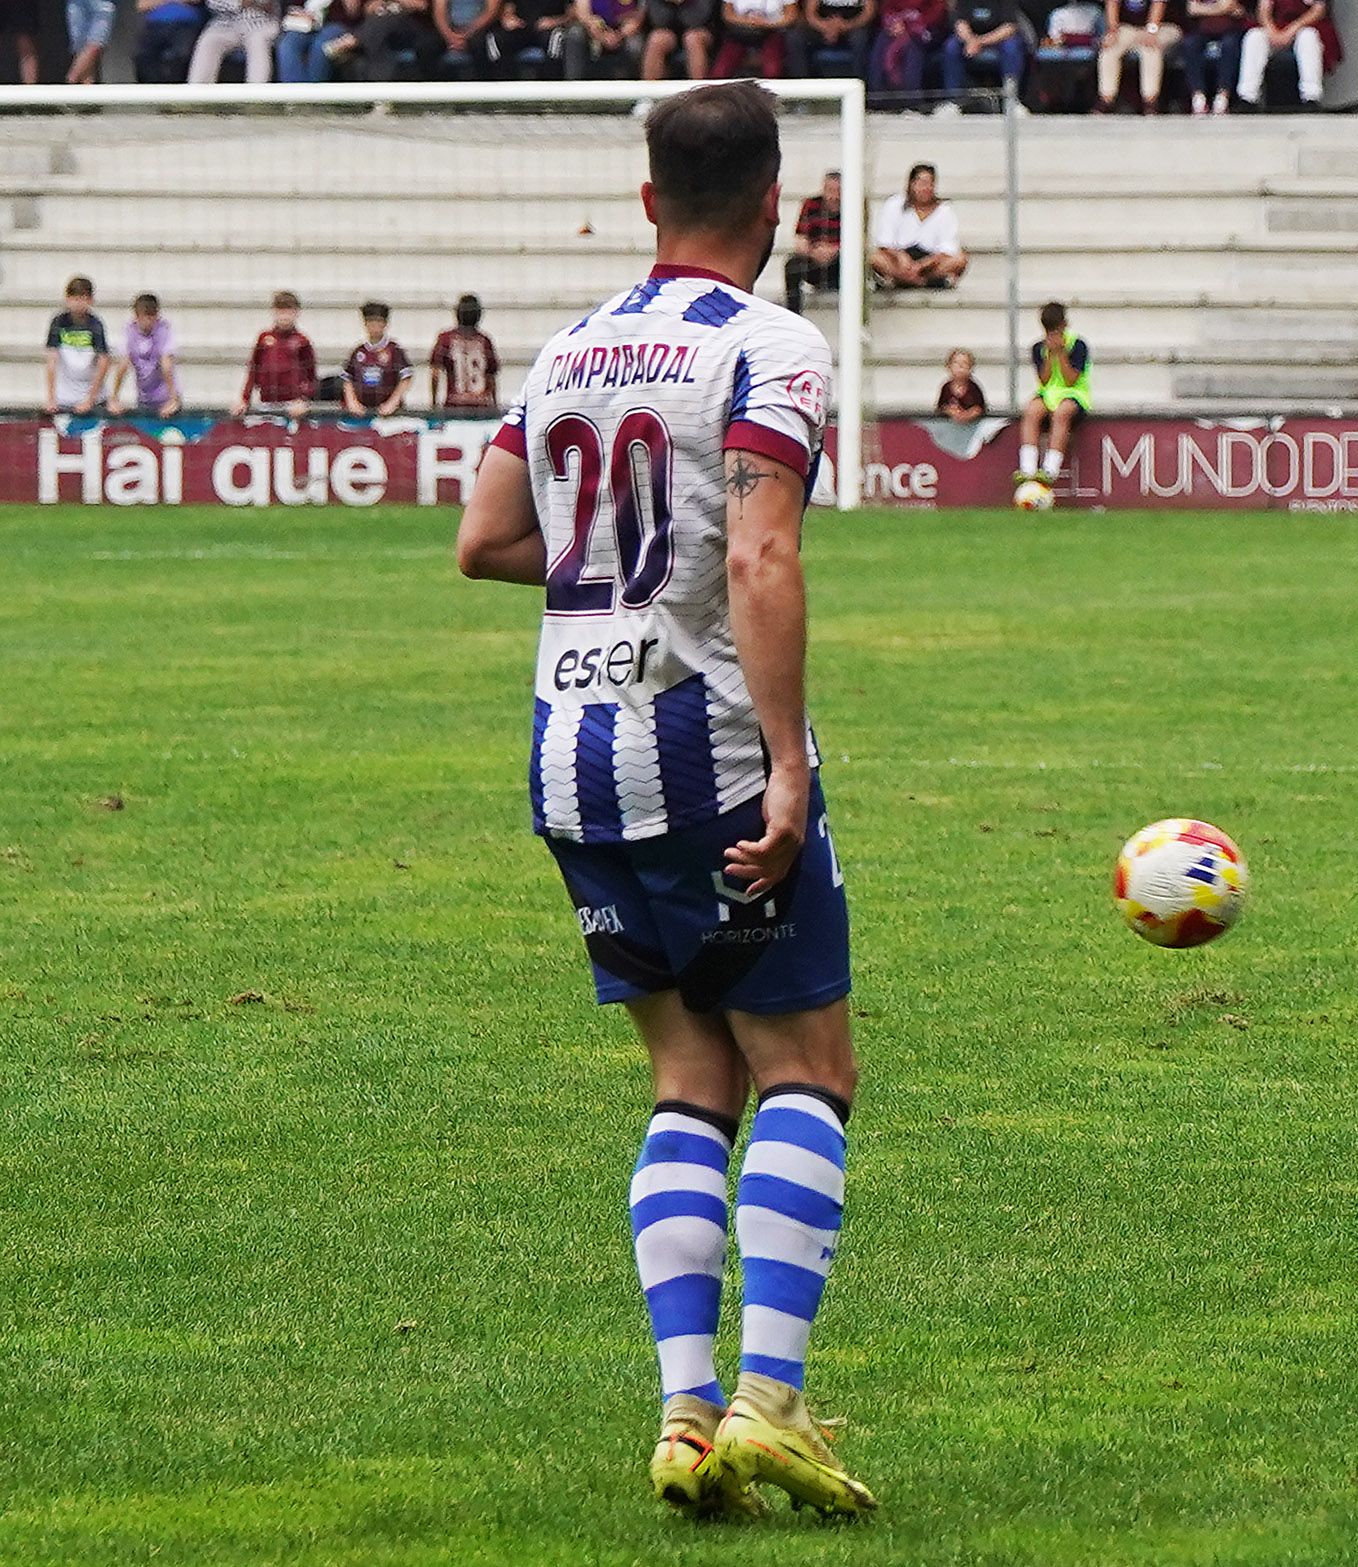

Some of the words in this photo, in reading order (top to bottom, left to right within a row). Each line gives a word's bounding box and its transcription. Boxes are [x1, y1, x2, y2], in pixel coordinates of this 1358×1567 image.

[546, 343, 701, 396] CAMPABADAL
[37, 427, 183, 505] Hai
[211, 444, 389, 507] que
[860, 462, 939, 499] nce
[543, 406, 675, 617] 20
[701, 923, 799, 945] HORIZONTE
